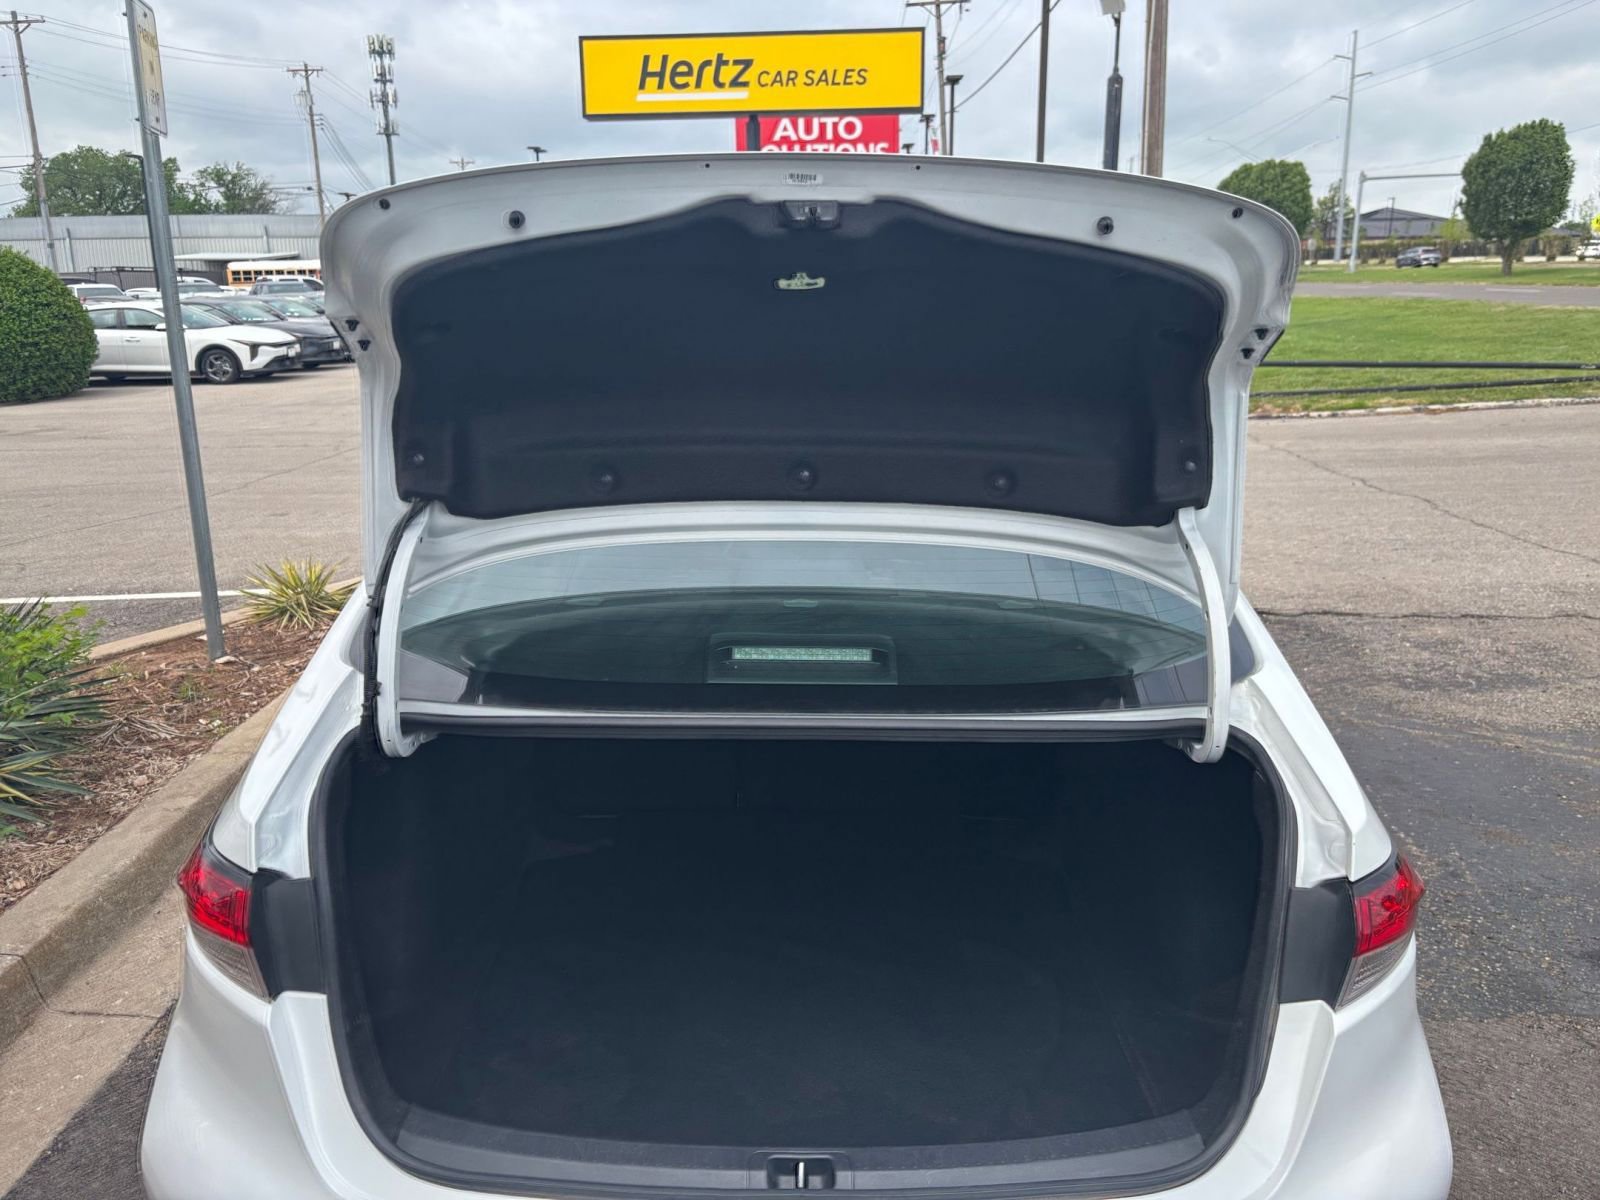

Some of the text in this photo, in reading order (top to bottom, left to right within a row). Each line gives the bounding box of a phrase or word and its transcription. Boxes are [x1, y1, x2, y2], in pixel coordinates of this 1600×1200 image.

[638, 53, 868, 90] Hertz CAR SALES
[773, 116, 863, 141] AUTO
